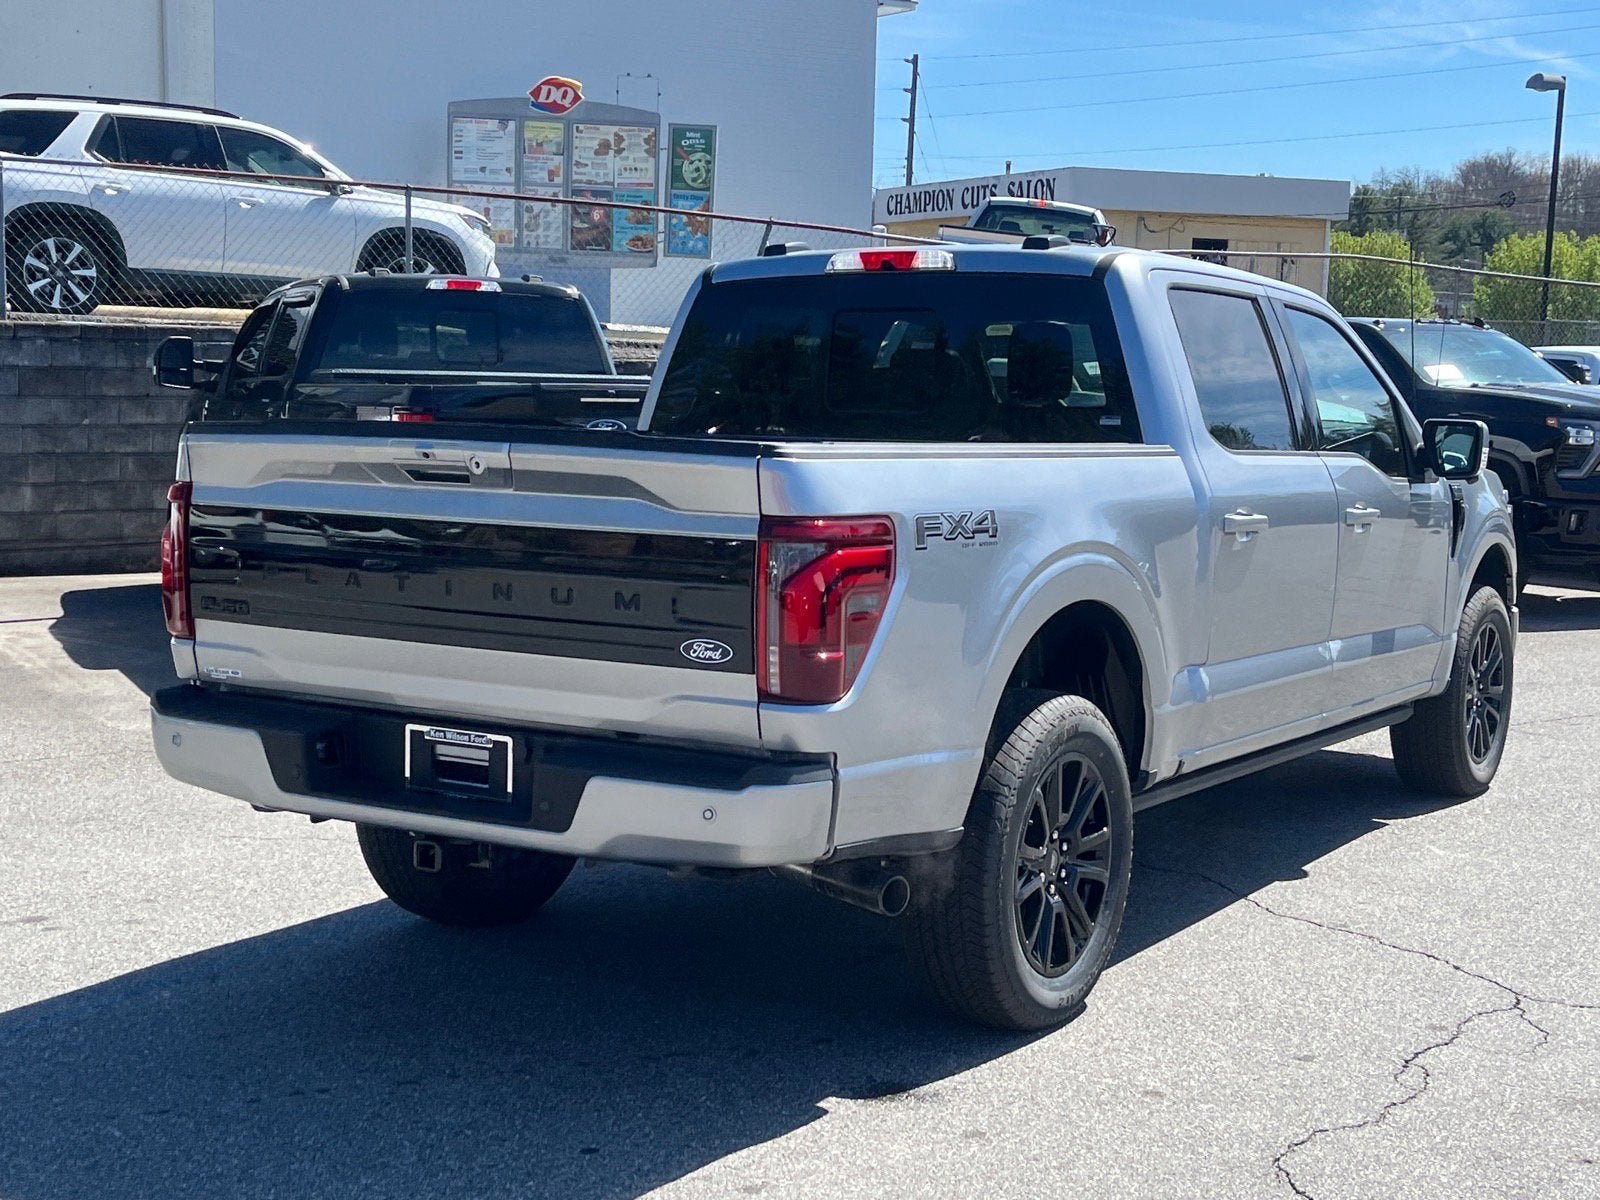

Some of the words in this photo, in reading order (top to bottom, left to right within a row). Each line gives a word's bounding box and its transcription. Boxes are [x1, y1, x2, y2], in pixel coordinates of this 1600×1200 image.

[537, 85, 575, 107] DQ
[886, 188, 956, 216] CHAMPION
[961, 183, 998, 210] CUTS
[1007, 177, 1057, 201] SALON
[913, 509, 998, 550] FX4
[262, 567, 642, 612] PLATINUM
[690, 640, 723, 660] Ford
[430, 729, 444, 739] Ken
[446, 731, 469, 743] Wilson
[470, 735, 487, 744] Ford
